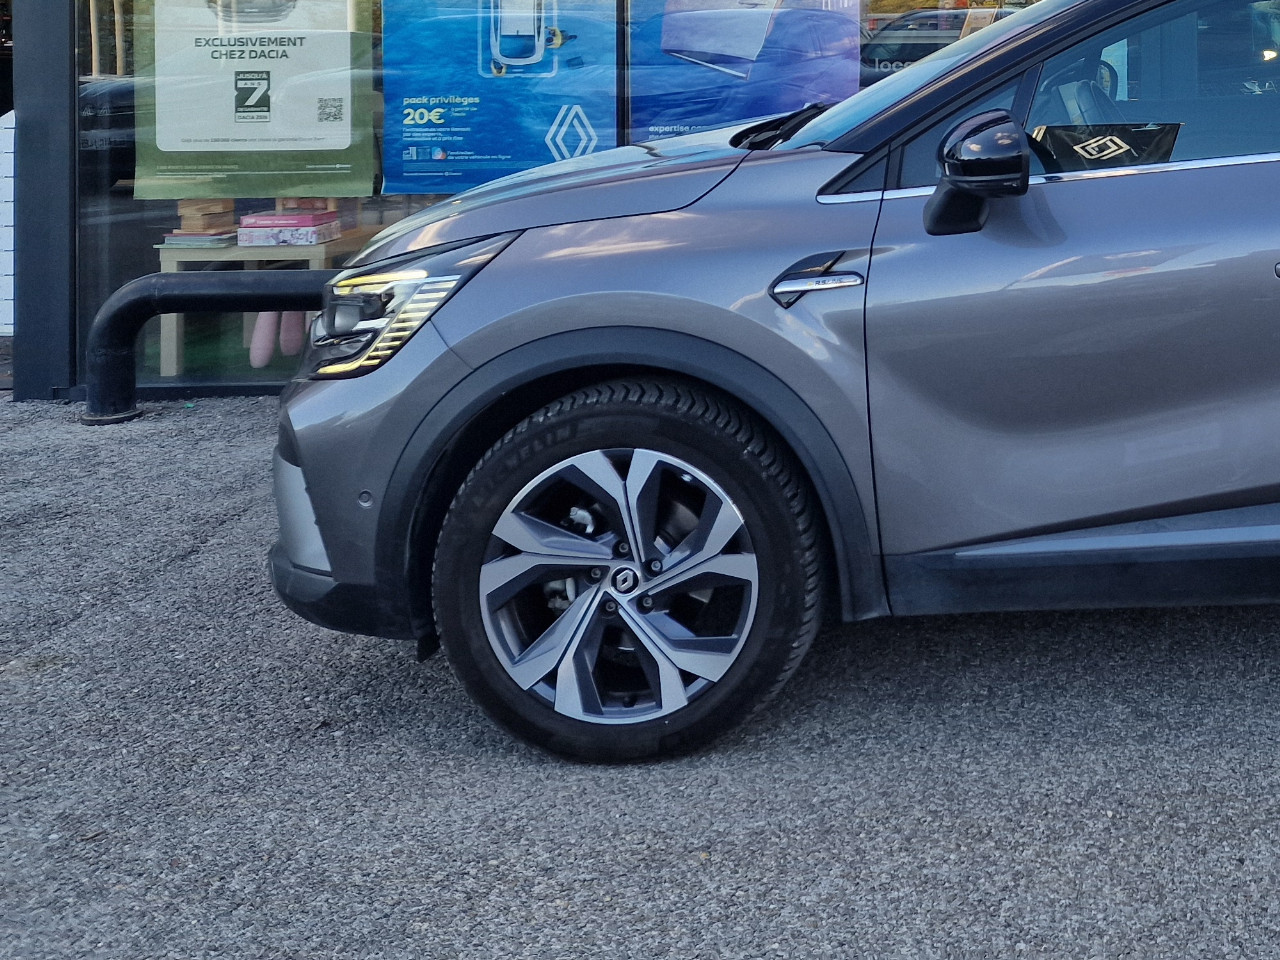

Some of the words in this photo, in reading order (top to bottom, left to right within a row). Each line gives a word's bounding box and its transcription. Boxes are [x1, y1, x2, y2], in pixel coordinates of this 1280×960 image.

[194, 36, 306, 48] EXCLUSIVEMENT
[210, 49, 246, 60] CHEZ
[248, 49, 289, 60] DACIA
[402, 96, 429, 106] pack
[429, 95, 481, 106] privilèges
[648, 123, 690, 133] expertise
